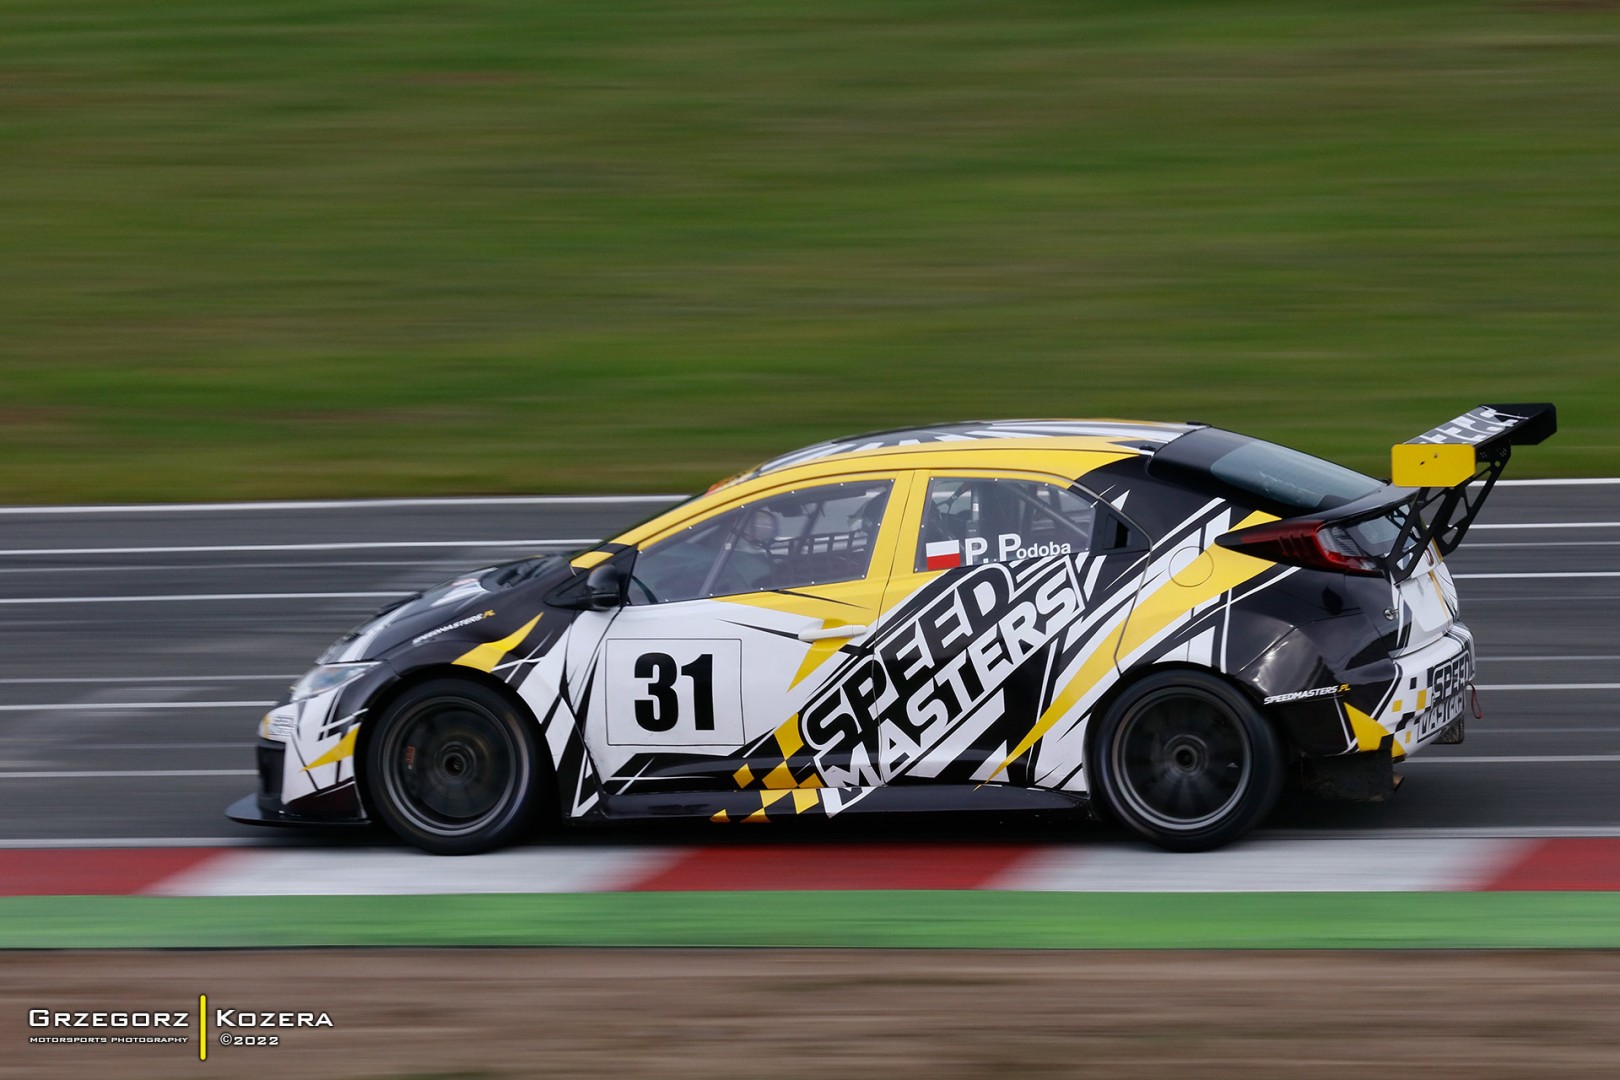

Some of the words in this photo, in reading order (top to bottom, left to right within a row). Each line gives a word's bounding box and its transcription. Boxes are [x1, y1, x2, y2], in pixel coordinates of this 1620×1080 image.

[964, 536, 989, 566] P.
[634, 652, 715, 732] 31
[802, 563, 1012, 750] SPEED
[814, 564, 1084, 818] MASTERS
